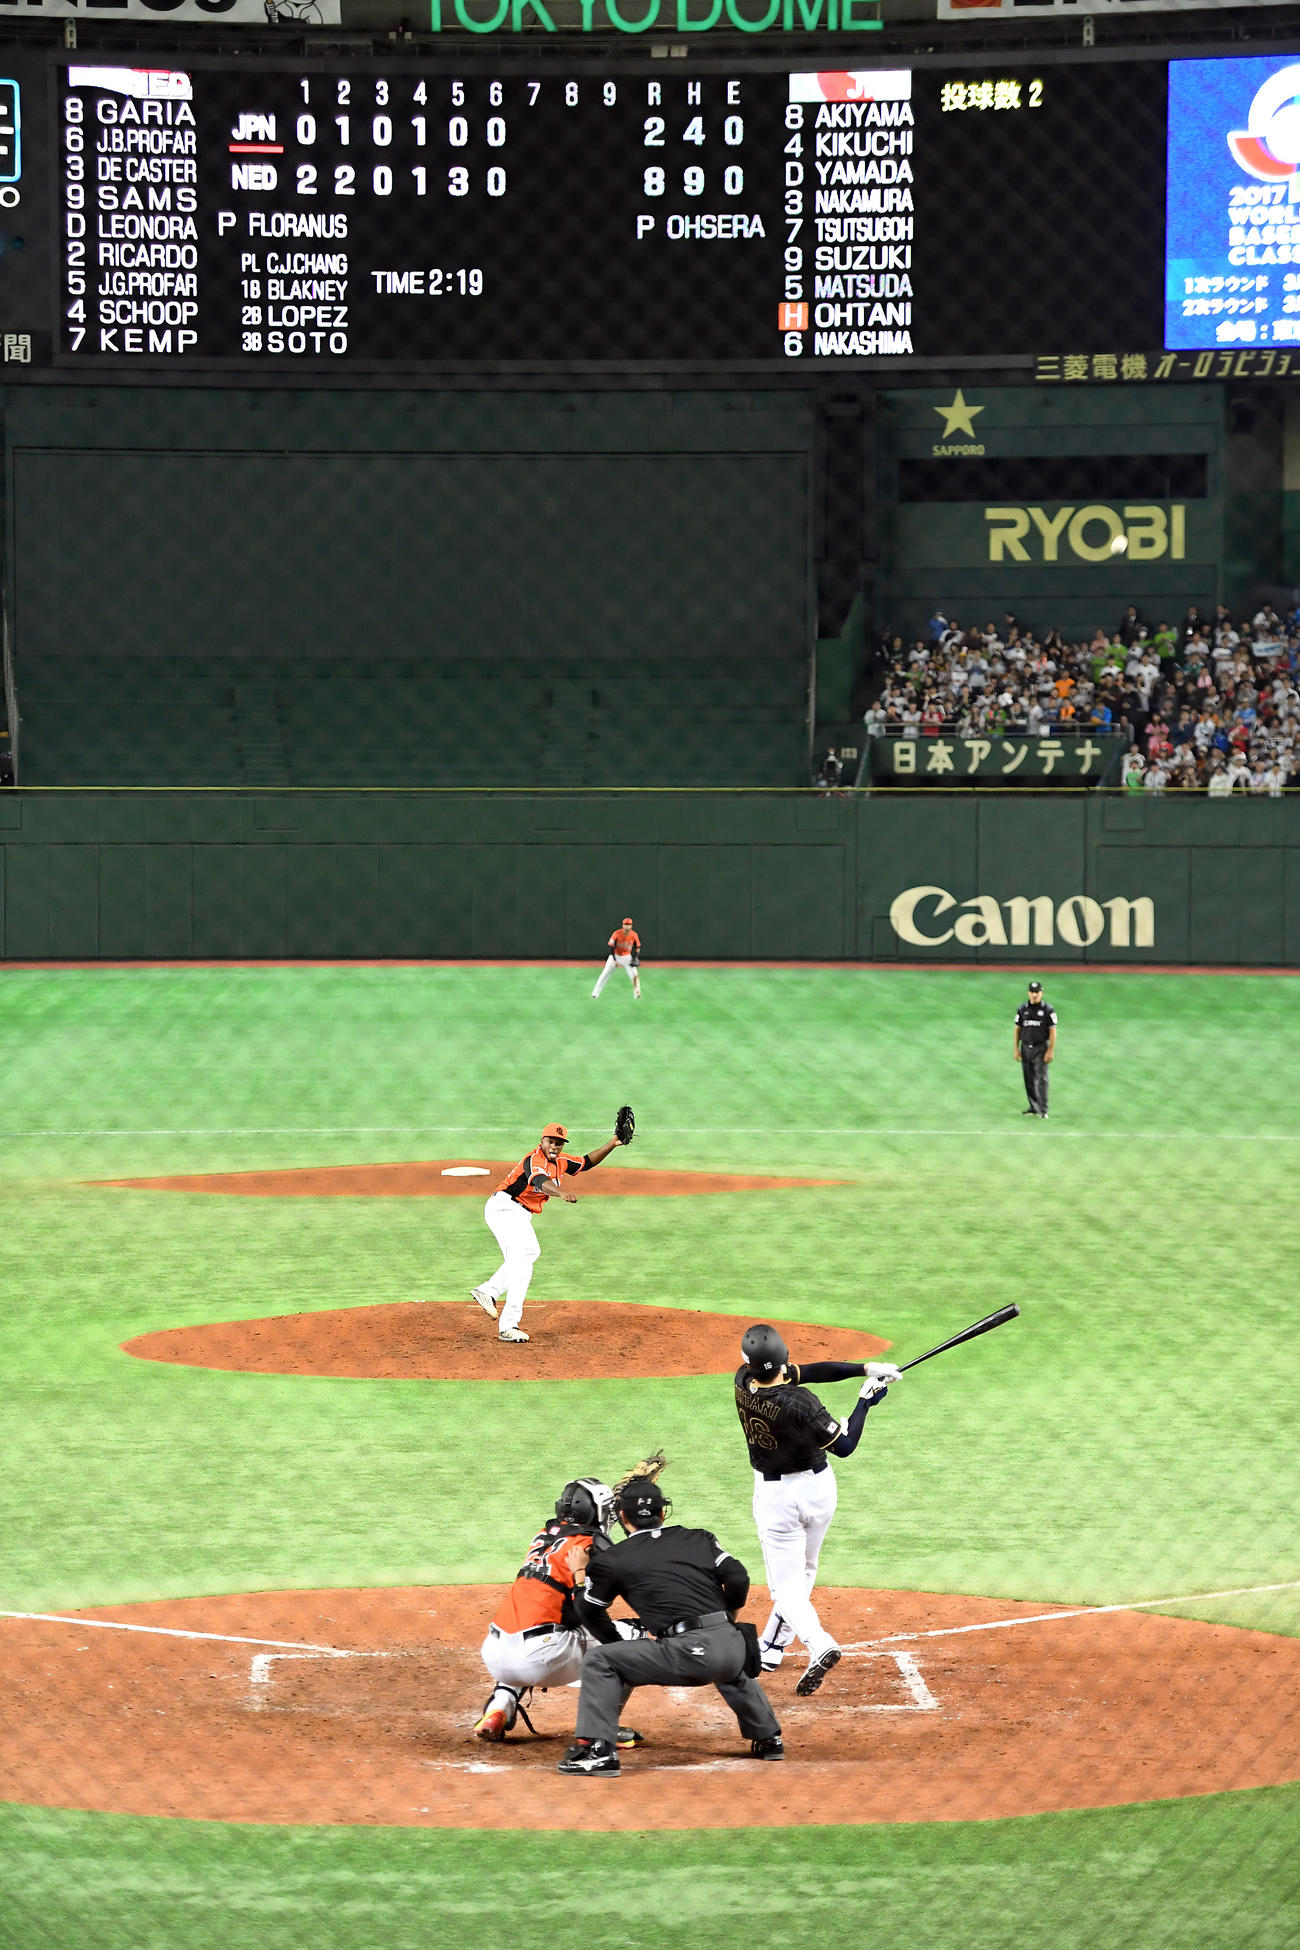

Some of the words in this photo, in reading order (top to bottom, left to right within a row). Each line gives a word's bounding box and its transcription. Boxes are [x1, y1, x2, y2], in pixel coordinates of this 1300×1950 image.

[301, 80, 309, 104] 1
[338, 80, 350, 104] 2
[376, 80, 388, 105] 3
[413, 82, 427, 105] 4
[452, 82, 464, 106] 5
[490, 82, 502, 106] 6
[528, 83, 540, 106] 7
[566, 82, 578, 106] 8
[604, 82, 616, 106] 9
[648, 82, 661, 105] R
[688, 82, 701, 105] H
[728, 81, 740, 104] E
[941, 80, 1021, 111] 投球数
[1028, 79, 1044, 108] 2
[66, 100, 83, 123] 8
[97, 100, 196, 125] GARIA
[785, 104, 804, 129] 8
[815, 102, 914, 128] AKIYAMA
[66, 128, 83, 151] 6
[97, 128, 196, 154] J.B.PROFAR
[232, 114, 276, 141] JPN
[297, 115, 316, 145] 0
[335, 116, 349, 145] 1
[373, 116, 392, 146] 0
[412, 117, 425, 145] 1
[449, 117, 468, 146] 0
[487, 117, 505, 146] 0
[644, 117, 665, 145] 2
[683, 117, 705, 145] 4
[725, 116, 743, 145] 0
[784, 133, 803, 157] 4
[816, 131, 913, 157] KIKUCHI
[67, 157, 84, 180] 3
[98, 157, 122, 181] DE
[126, 158, 197, 183] CASTER
[232, 164, 277, 190] NED
[297, 165, 317, 194] 2
[335, 165, 355, 195] 2
[373, 166, 392, 195] 0
[412, 167, 426, 195] 1
[449, 167, 468, 196] 3
[487, 167, 506, 196] 0
[644, 167, 665, 196] 8
[684, 166, 704, 195] 9
[725, 166, 743, 195] 0
[786, 162, 803, 186] D
[815, 159, 913, 185] YAMADA
[67, 185, 84, 209] 9
[99, 186, 197, 211] SAMS
[785, 190, 802, 214] 3
[816, 188, 914, 214] NAKAMURA
[1229, 185, 1287, 206] 2017
[68, 214, 85, 237] D
[99, 214, 198, 240] LEONORA
[219, 212, 236, 236] P
[249, 213, 347, 238] FLORANUS
[637, 215, 655, 239] P
[667, 214, 765, 239] OHSERA
[1228, 205, 1300, 225] WORL
[785, 219, 803, 243] 7
[815, 217, 913, 242] TSUTSUGOH
[68, 243, 85, 266] 2
[99, 243, 197, 269] RICARDO
[242, 253, 260, 272] PL
[267, 253, 347, 275] C.J.CHANG
[785, 247, 802, 271] 9
[815, 245, 911, 270] SUZUKI
[68, 271, 86, 294] 5
[99, 272, 197, 296] J.G.PROFAR
[241, 280, 261, 298] 1B
[268, 279, 348, 301] BLAKNEY
[371, 271, 424, 294] TIME
[430, 269, 482, 295] 2:19
[785, 275, 803, 299] 5
[815, 274, 913, 299] MATSUDA
[68, 300, 86, 323] 4
[100, 300, 198, 325] SCHOOP
[242, 306, 262, 325] 2B
[268, 306, 348, 327] LOPEZ
[785, 304, 802, 328] H
[815, 302, 911, 327] OHTANI
[69, 329, 86, 351] 7
[101, 329, 197, 353] KEMP
[242, 332, 262, 351] 3B
[268, 331, 347, 353] SOTO
[784, 331, 803, 356] 6
[815, 331, 913, 356] NAKASHIMA
[1035, 353, 1148, 381] 三菱電機
[932, 444, 985, 456] SAPPORO
[985, 504, 1186, 562] RYOBI
[893, 739, 1102, 775] 日本アンテナ
[889, 885, 1155, 948] Canon
[763, 1361, 773, 1371] 16
